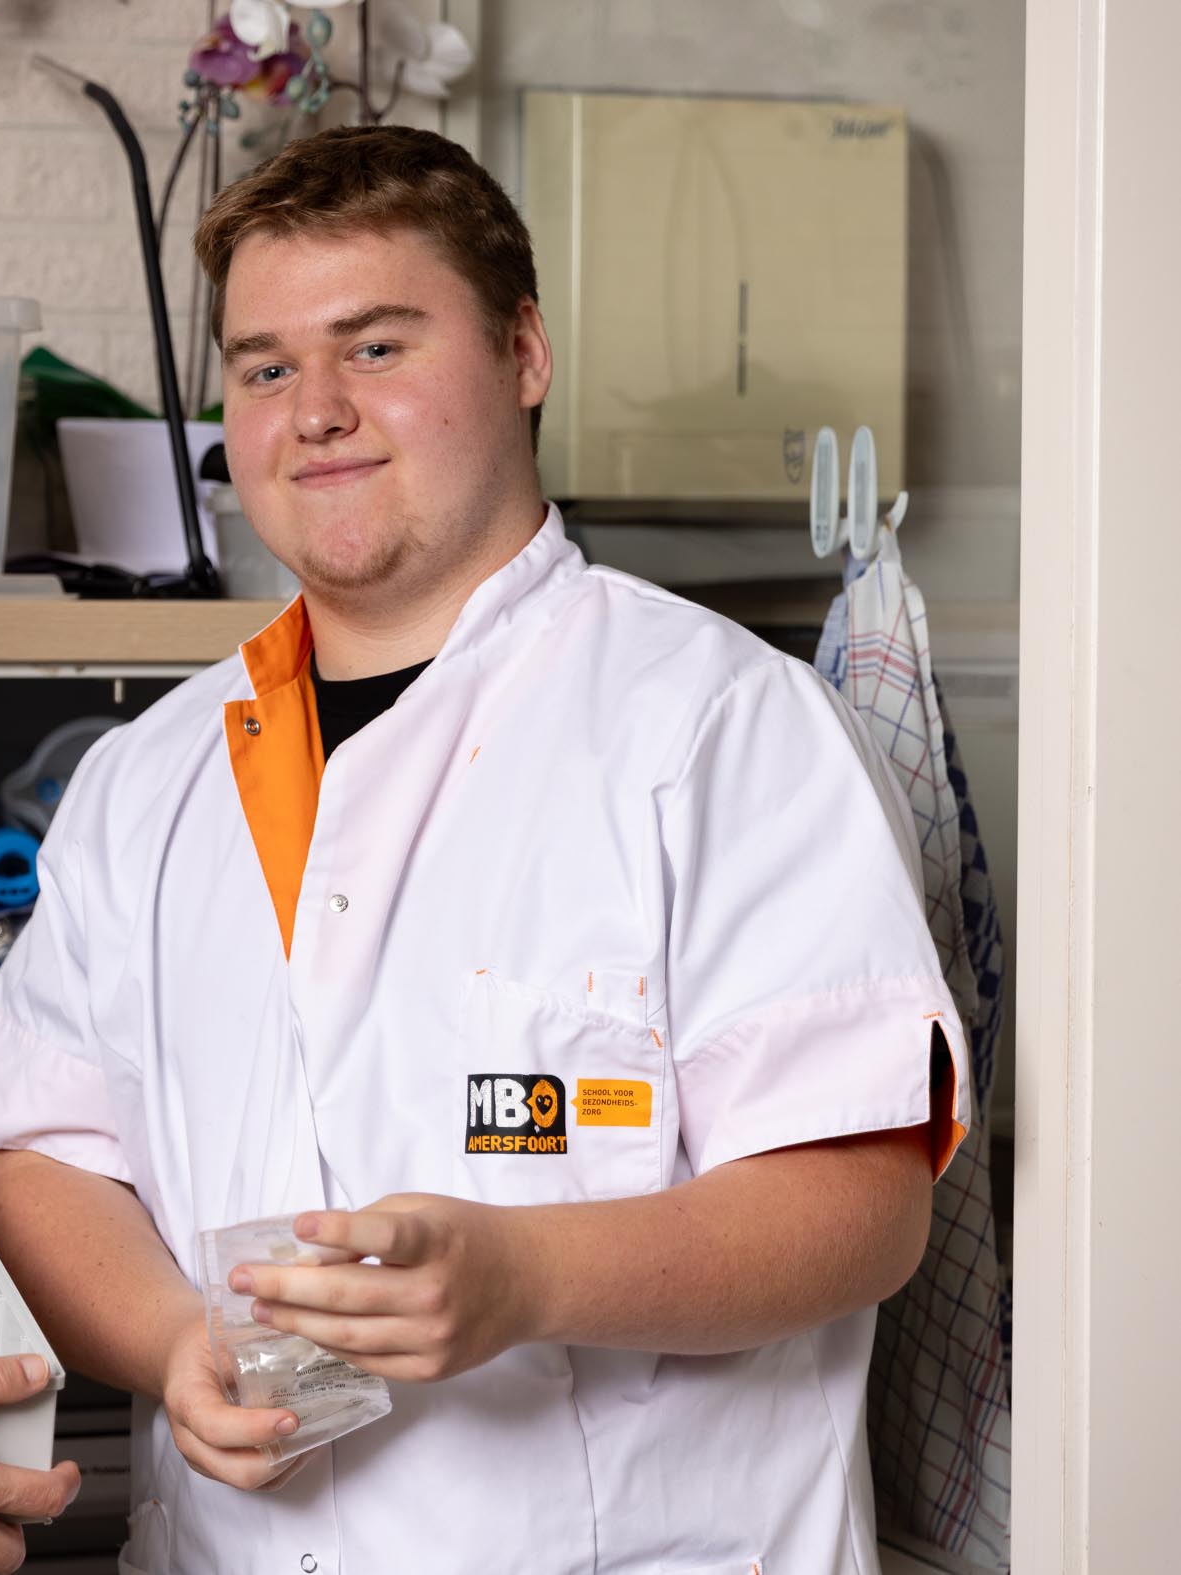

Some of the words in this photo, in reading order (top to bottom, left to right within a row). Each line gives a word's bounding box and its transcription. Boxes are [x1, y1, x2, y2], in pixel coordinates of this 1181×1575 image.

[613, 1089, 634, 1097] VOOR
[469, 1078, 558, 1129] MBO
[582, 1098, 639, 1107] GEZONDHEIDS-
[582, 1108, 602, 1116] ZORG
[468, 1135, 567, 1152] AMERSFOORT
